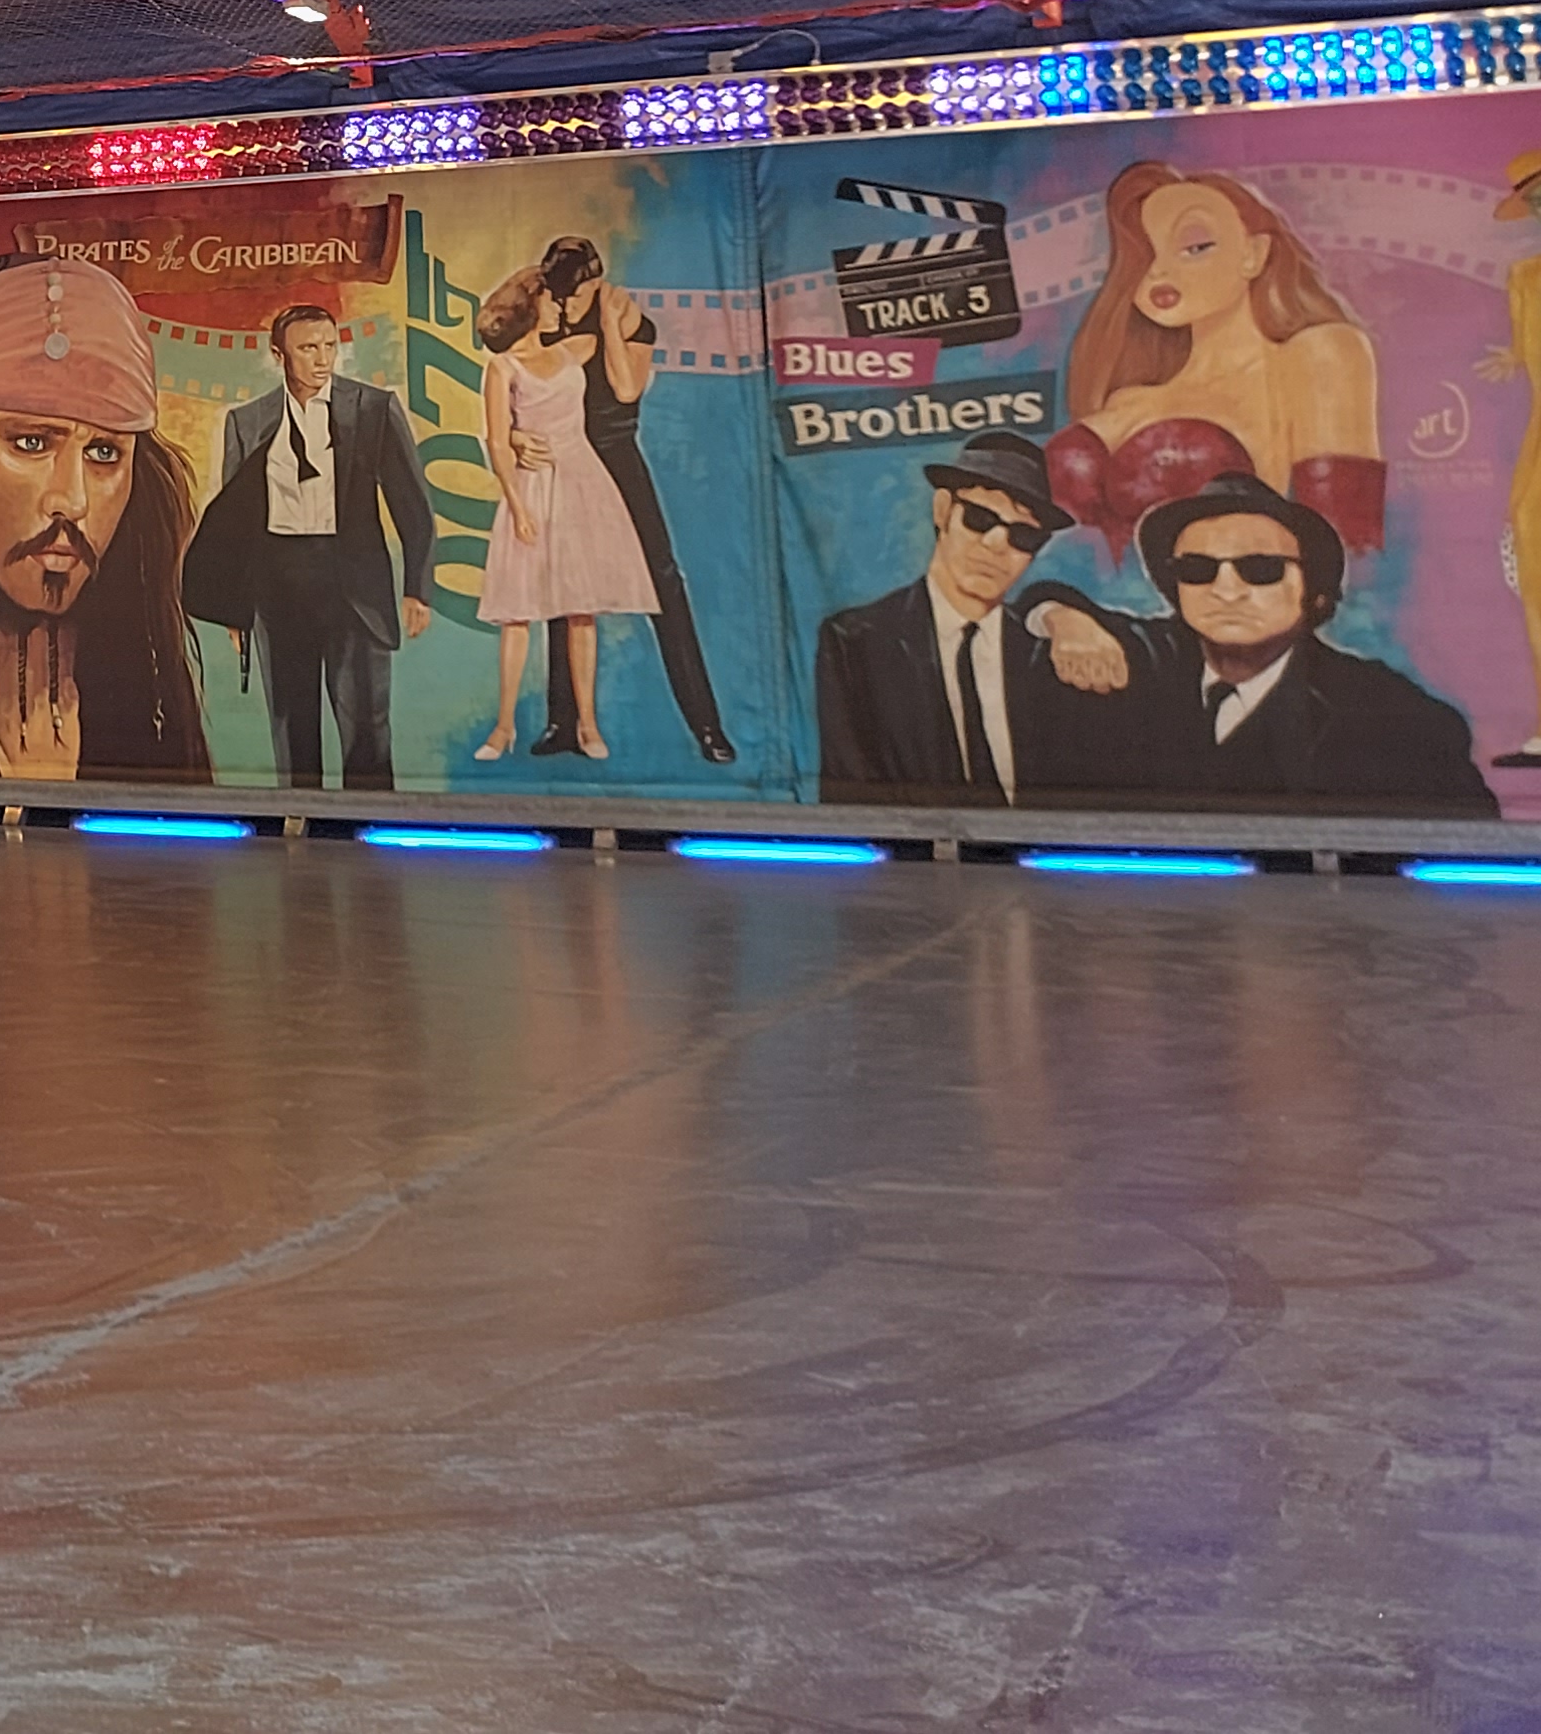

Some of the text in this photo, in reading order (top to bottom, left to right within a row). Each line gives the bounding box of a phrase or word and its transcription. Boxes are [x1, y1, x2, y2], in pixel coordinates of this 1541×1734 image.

[34, 234, 362, 274] PIRATES of the CARIBBEAN
[857, 292, 951, 330] TRACK
[782, 342, 915, 379] Blues
[788, 390, 1045, 447] Brothers
[405, 323, 502, 635] 007
